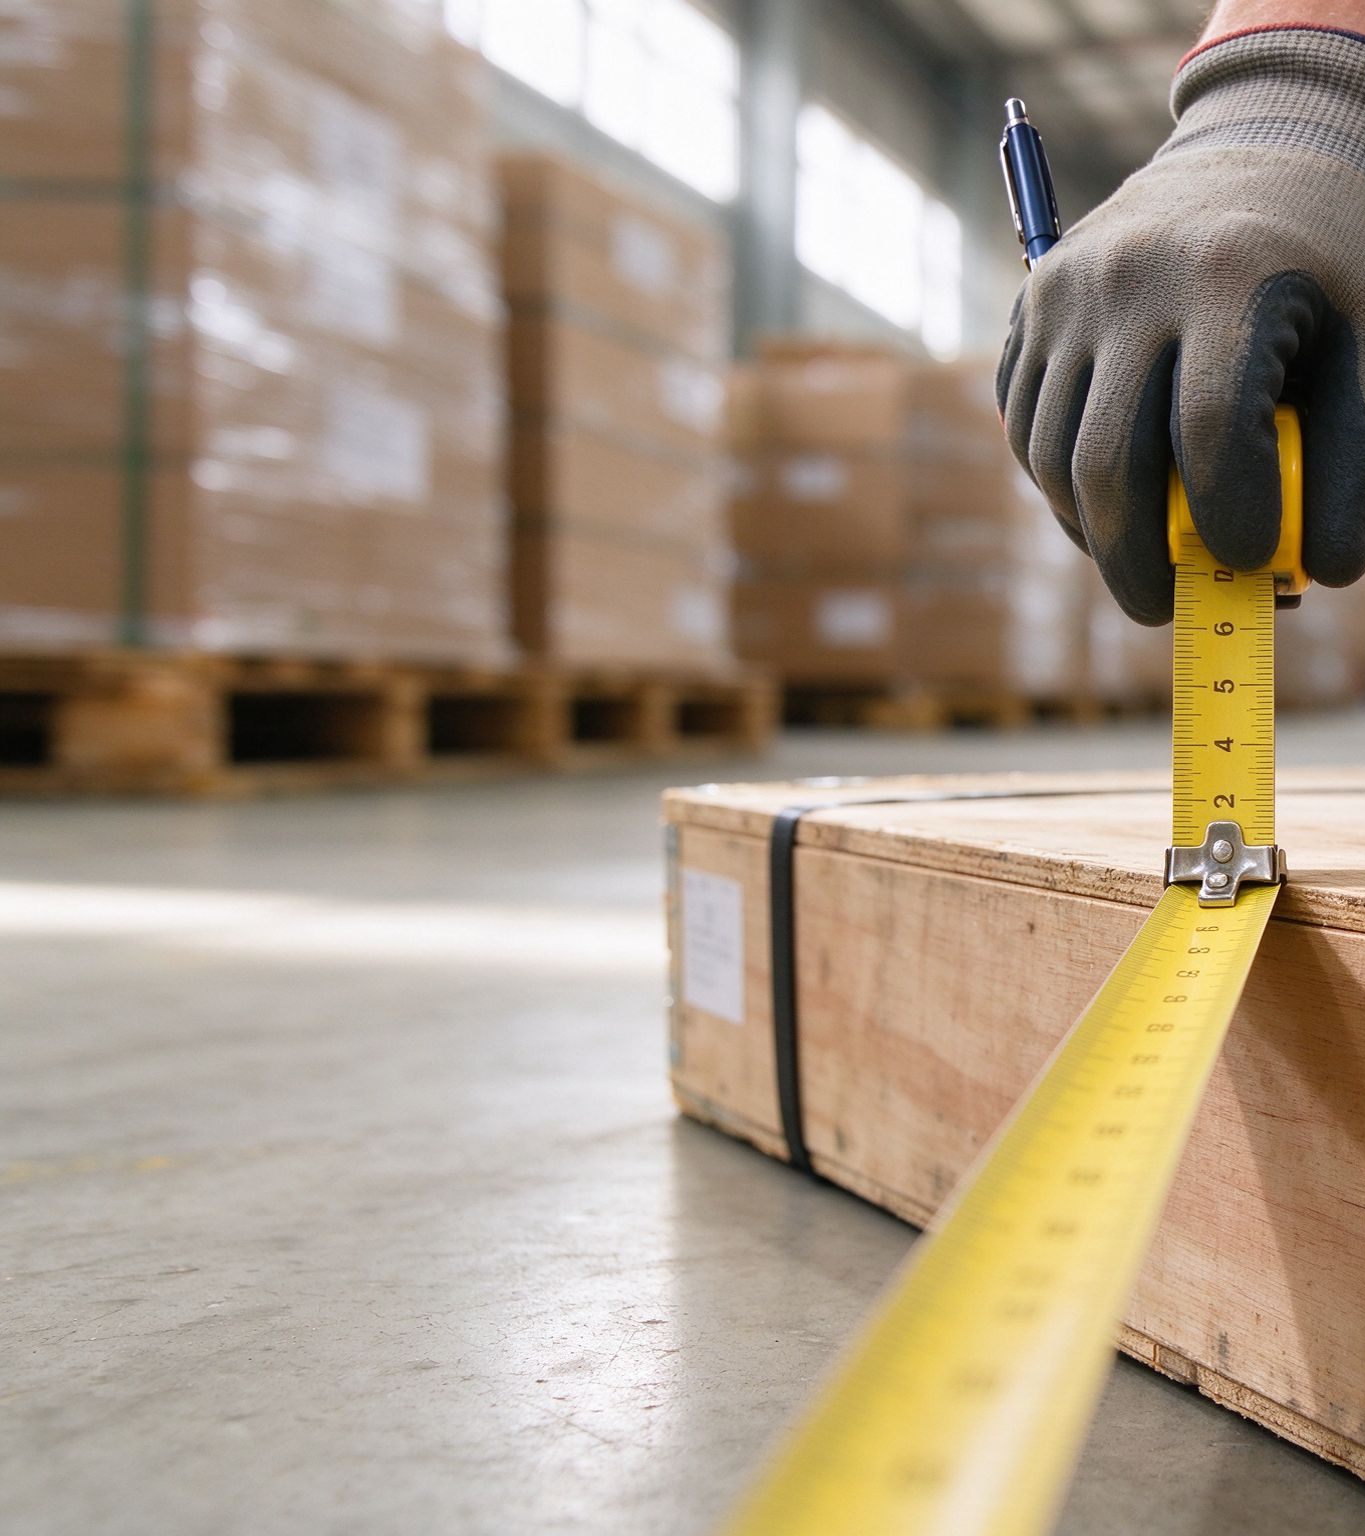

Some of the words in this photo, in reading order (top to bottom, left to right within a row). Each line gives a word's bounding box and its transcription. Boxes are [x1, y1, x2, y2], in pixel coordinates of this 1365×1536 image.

[1213, 622, 1235, 637] 6
[1213, 679, 1235, 694] 5
[1213, 736, 1235, 753] 4
[1213, 793, 1235, 809] 2
